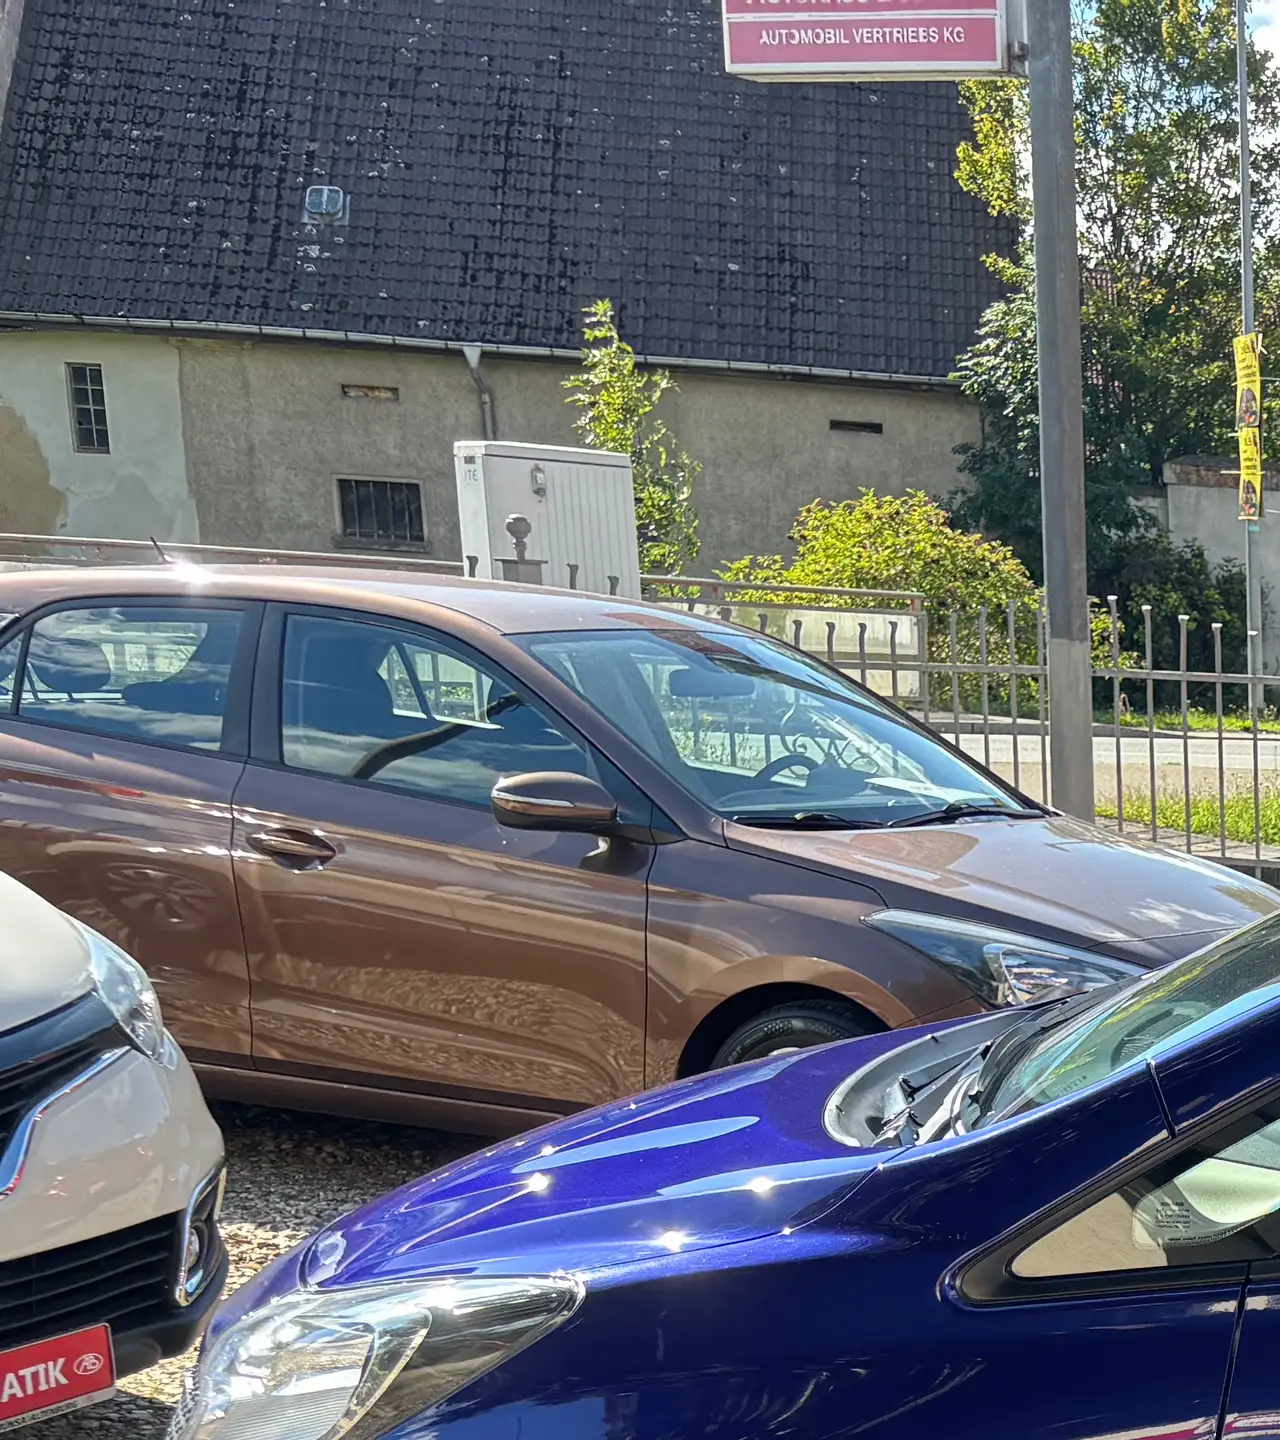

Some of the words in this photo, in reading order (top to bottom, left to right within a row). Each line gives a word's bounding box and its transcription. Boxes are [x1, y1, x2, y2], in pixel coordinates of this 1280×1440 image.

[759, 29, 850, 45] AUTOMOBIL
[852, 27, 939, 44] VERTRIEBS
[943, 26, 965, 43] KG
[1, 1357, 69, 1402] ATIK
